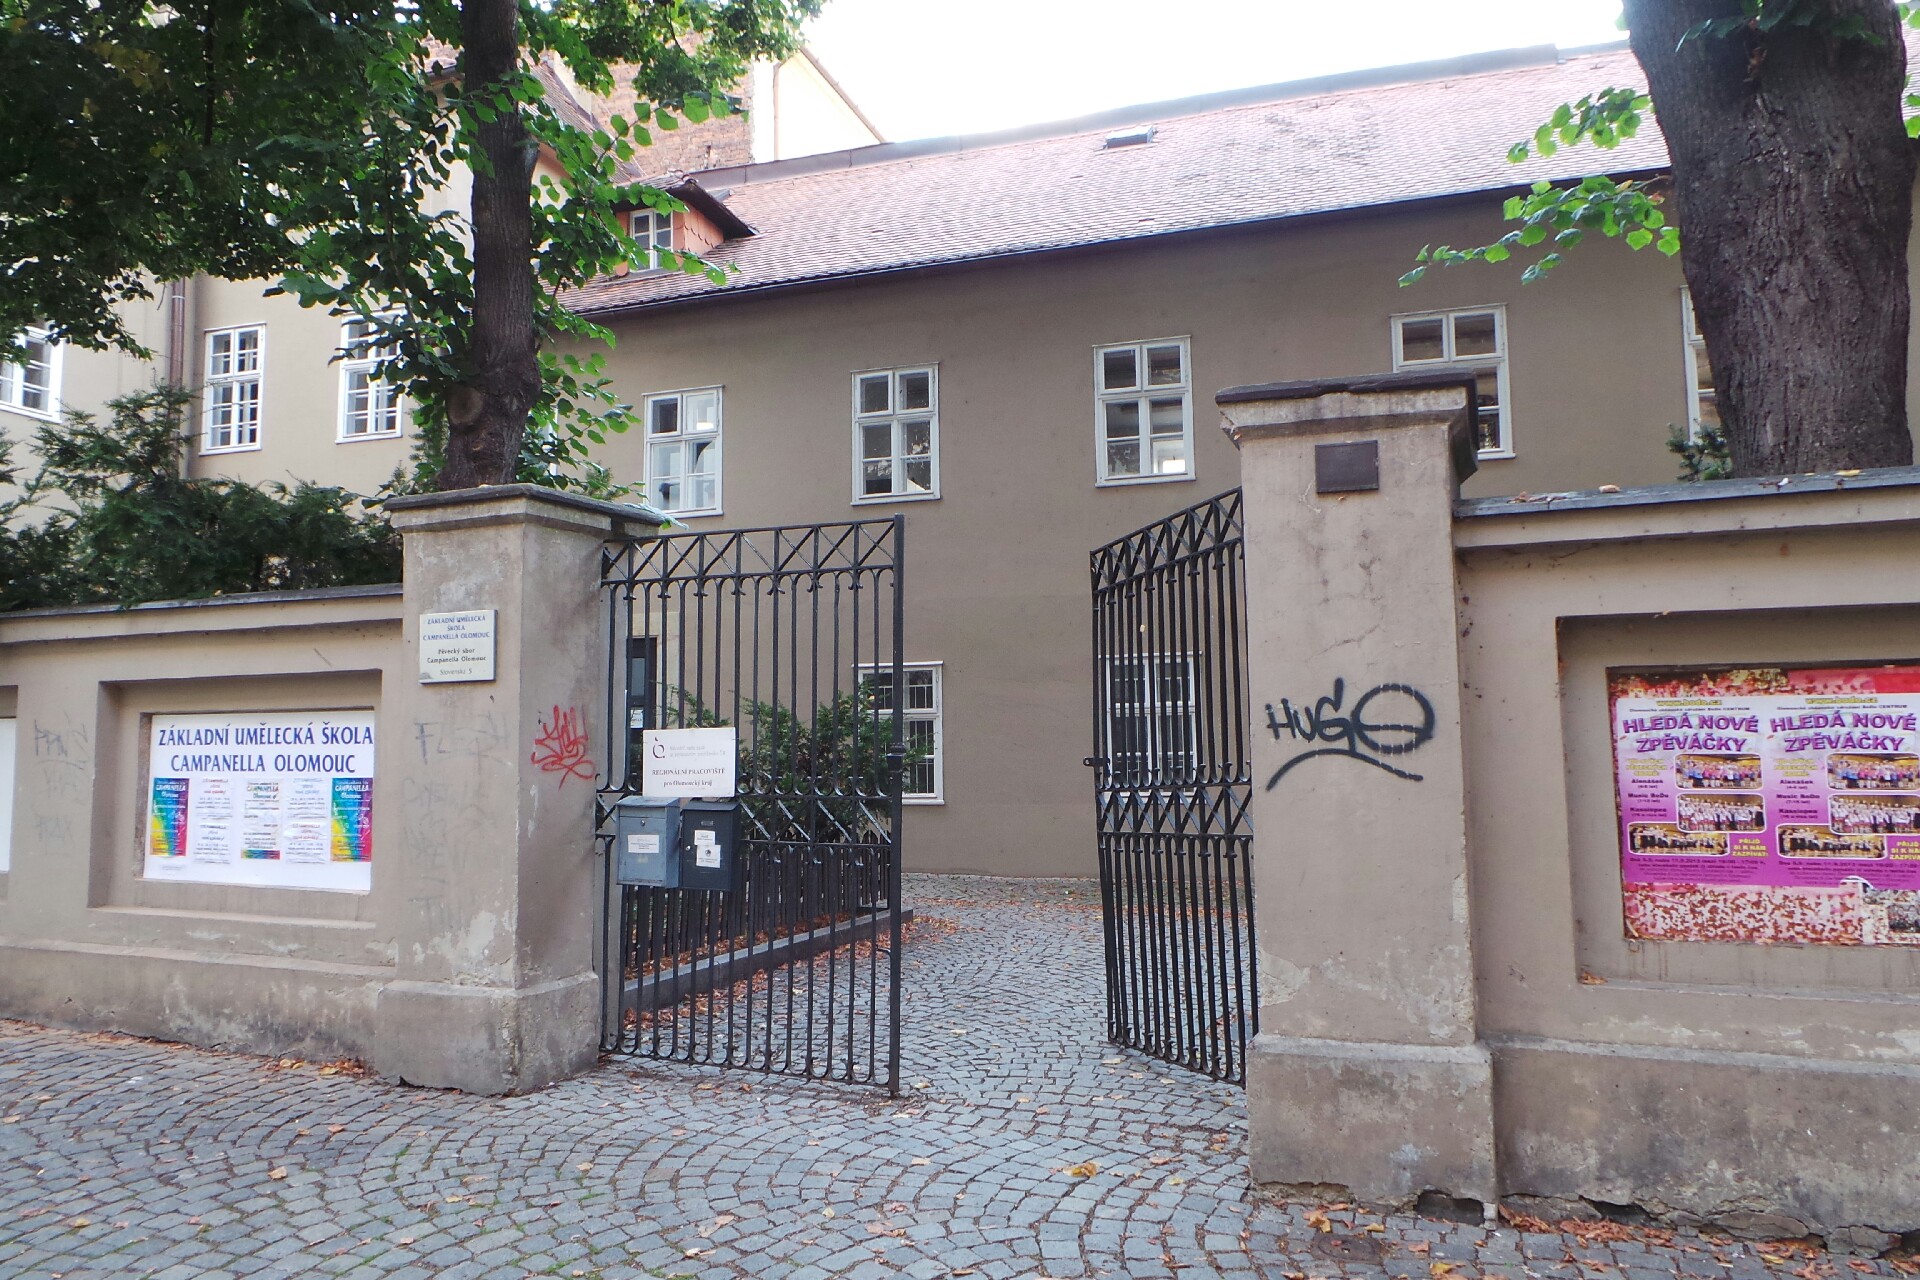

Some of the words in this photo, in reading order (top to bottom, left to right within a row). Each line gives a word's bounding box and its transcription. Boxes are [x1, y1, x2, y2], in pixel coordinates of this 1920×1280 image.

[1623, 712, 1693, 734] HLEDÁ
[1698, 714, 1759, 733] NOVÉ
[1770, 710, 1845, 733] HLEDÁ
[1852, 712, 1917, 731] NOVÉ
[158, 724, 231, 746] ZÁKLADNÍ
[235, 722, 315, 746] UMĚLECKÁ
[321, 721, 374, 745] ŠKOLA
[1636, 733, 1748, 753] ZPĚVÁČKY
[1784, 731, 1905, 752] ZPĚVÁČKY
[171, 754, 266, 773] CAMPANELLA
[274, 754, 356, 773] OLOMOUC
